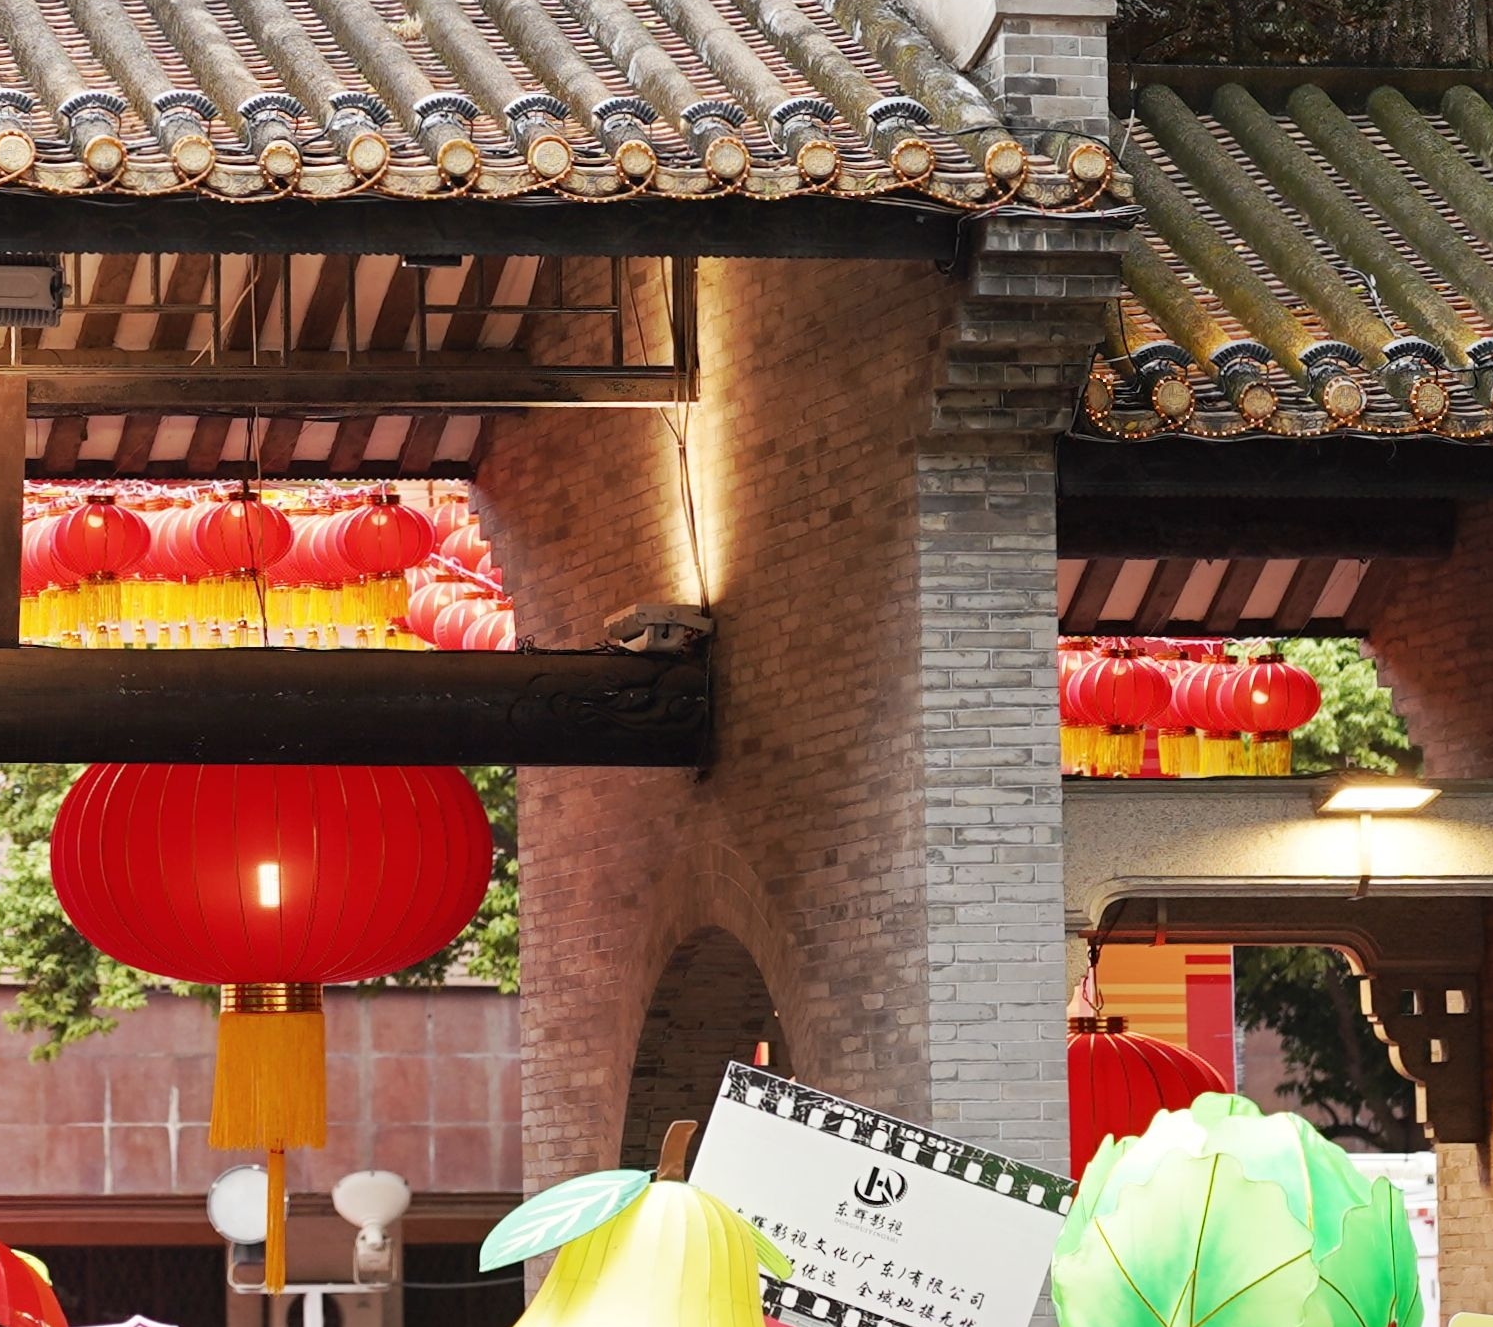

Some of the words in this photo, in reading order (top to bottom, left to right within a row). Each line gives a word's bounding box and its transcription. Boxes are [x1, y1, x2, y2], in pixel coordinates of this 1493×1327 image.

[736, 1207, 988, 1311] 辉影视文化(广东)有限公司
